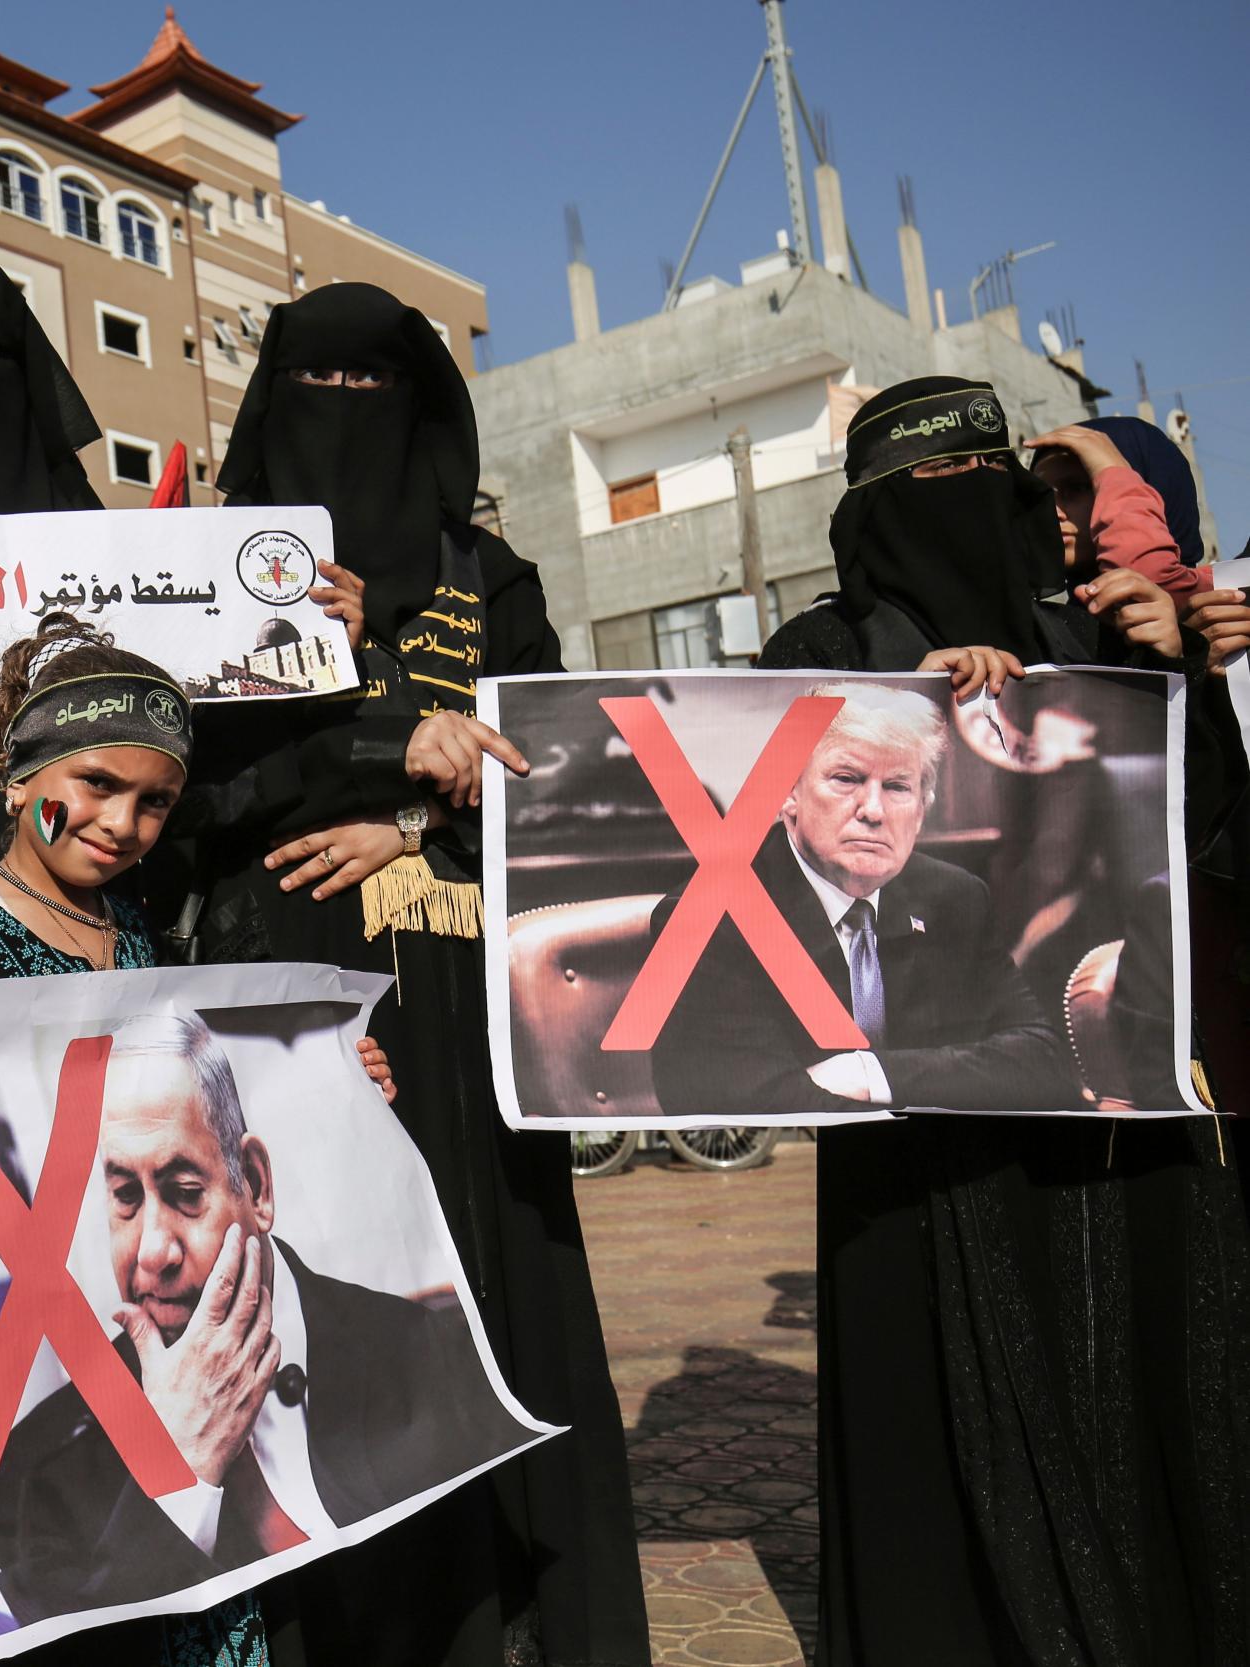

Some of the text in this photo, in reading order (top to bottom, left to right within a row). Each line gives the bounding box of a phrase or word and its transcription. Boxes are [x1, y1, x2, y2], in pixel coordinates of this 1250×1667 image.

[889, 410, 962, 441] الجهاد
[29, 572, 123, 618] مؤتمر
[130, 571, 221, 617] يسقط
[400, 631, 480, 666] الإسلامي
[55, 692, 136, 726] الجهاد
